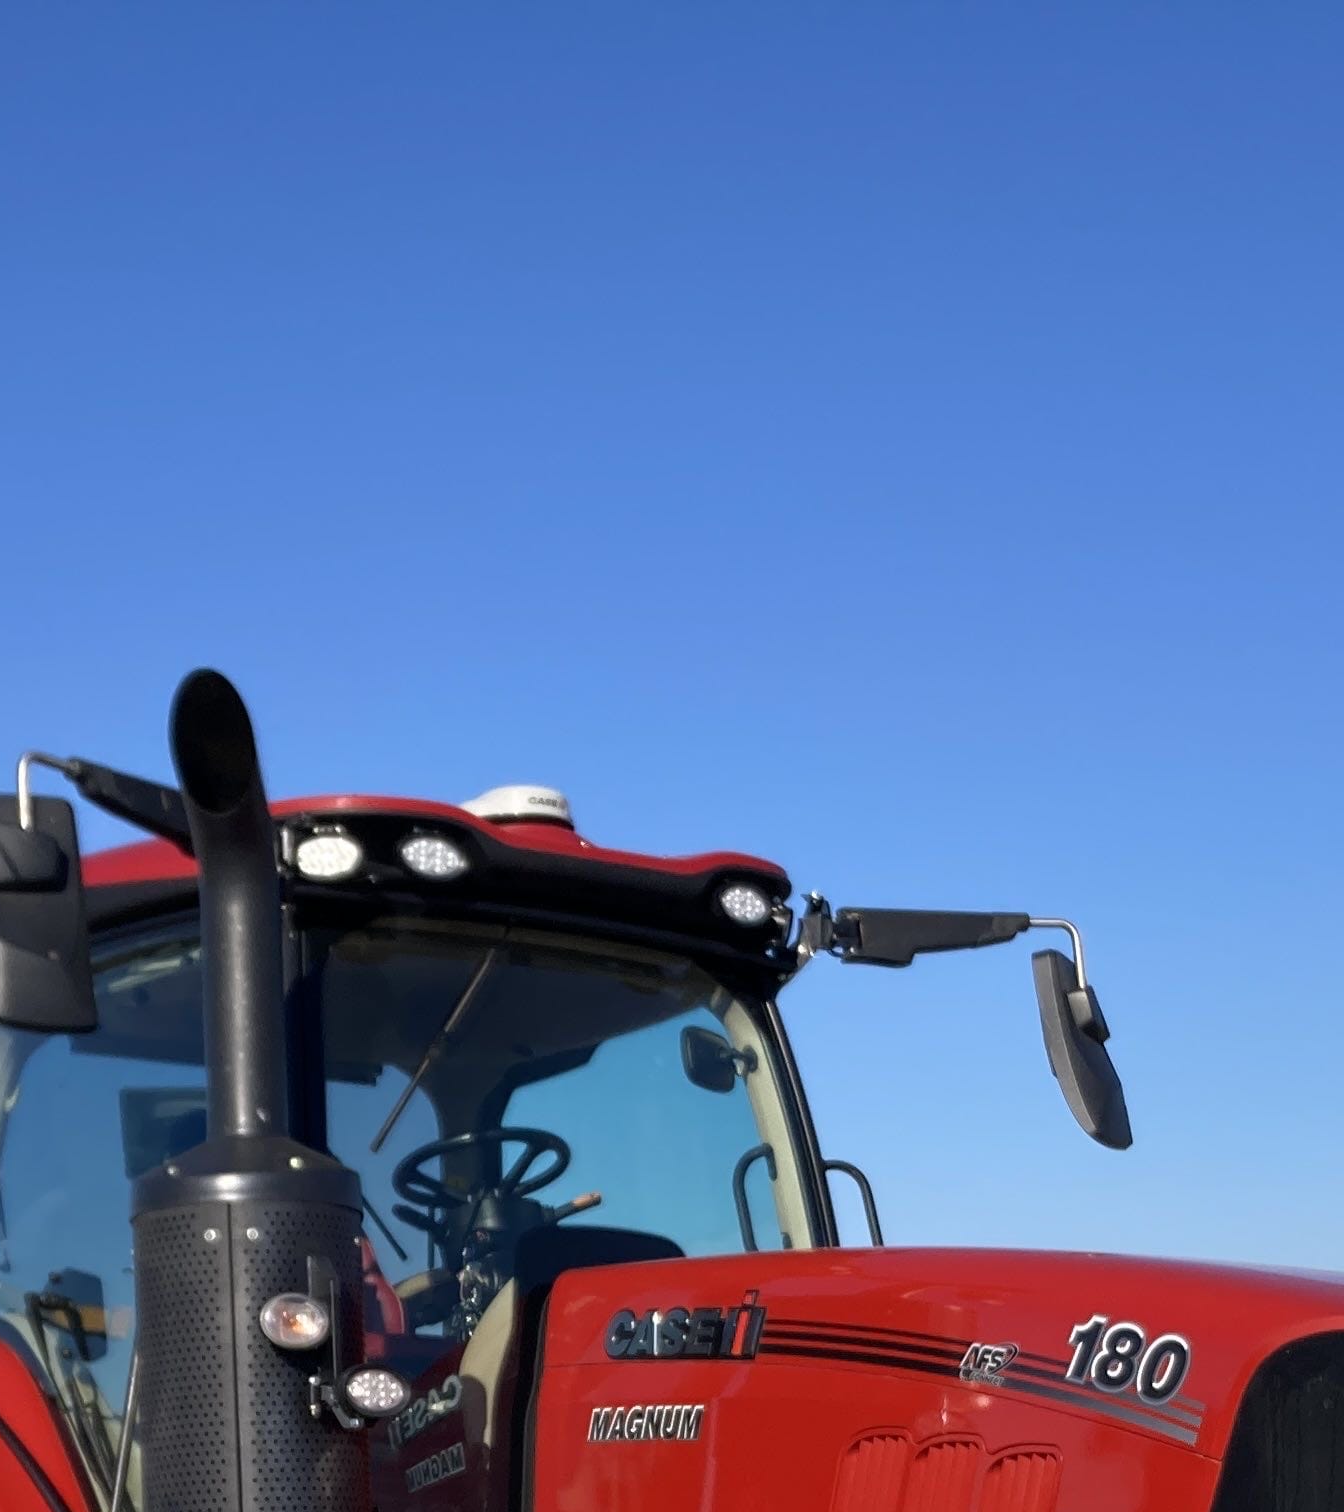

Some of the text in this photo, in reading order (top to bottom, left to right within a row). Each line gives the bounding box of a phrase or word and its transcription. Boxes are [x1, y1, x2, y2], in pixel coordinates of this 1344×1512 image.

[604, 1308, 723, 1359] CASE
[959, 1343, 1008, 1375] AFS
[1065, 1313, 1192, 1406] 180
[587, 1404, 705, 1442] MAGNUM
